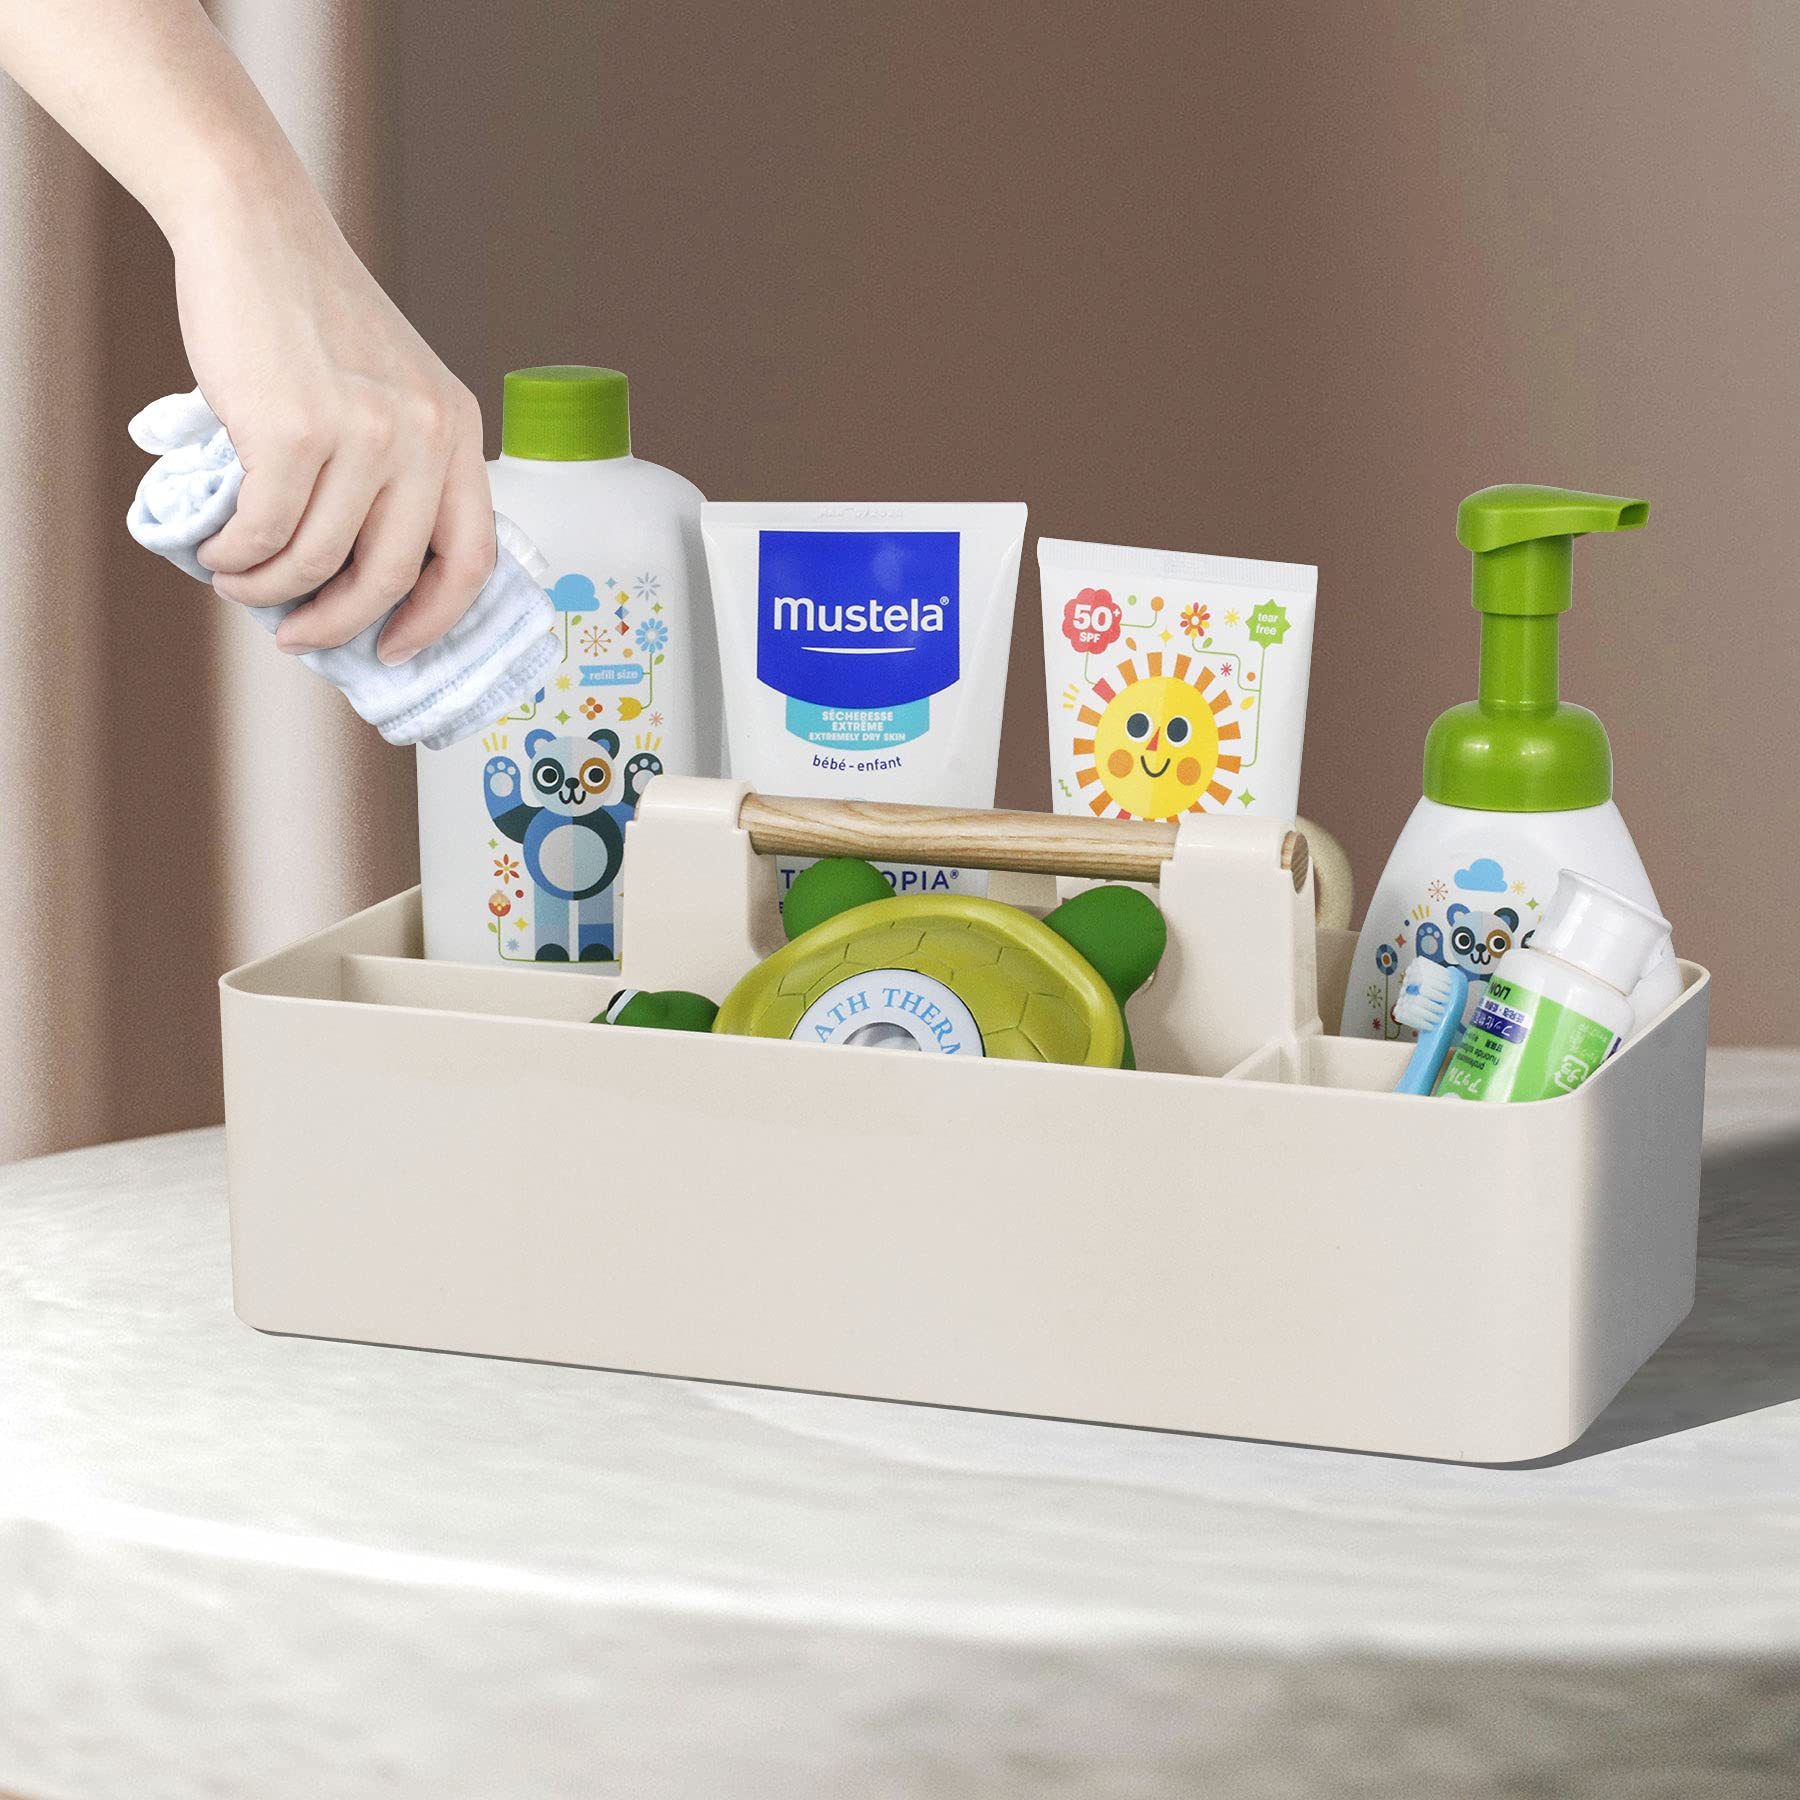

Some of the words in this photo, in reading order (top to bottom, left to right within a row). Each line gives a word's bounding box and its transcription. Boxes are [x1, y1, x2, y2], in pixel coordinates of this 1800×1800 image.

[1257, 612, 1279, 624] tear
[1255, 624, 1278, 636] free
[1079, 631, 1102, 643] SPF
[589, 669, 615, 681] refill
[616, 669, 639, 681] size
[822, 709, 894, 722] SÉCHERESSE
[832, 721, 884, 732] EXTRÊME
[809, 732, 860, 741] EXTREMELY
[862, 732, 882, 741] DRY
[883, 732, 907, 741] SKIN
[1488, 981, 1512, 1001] LION
